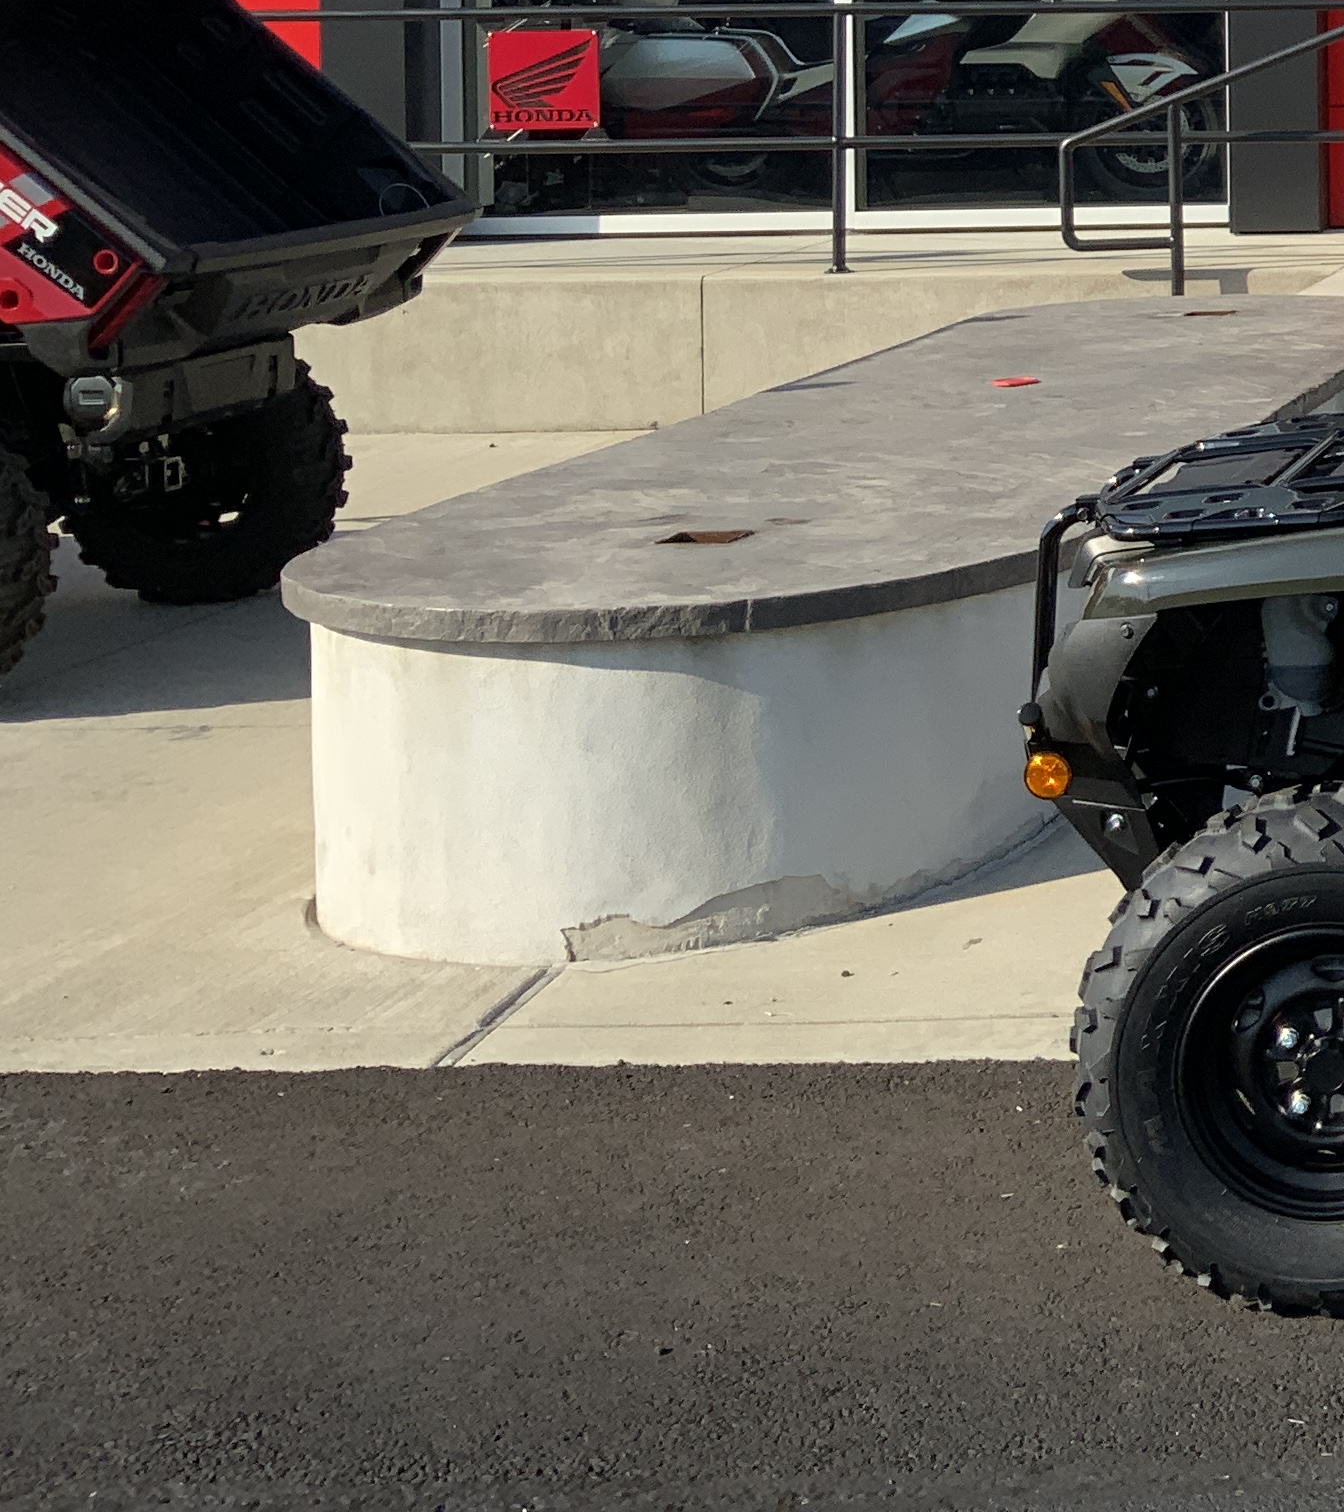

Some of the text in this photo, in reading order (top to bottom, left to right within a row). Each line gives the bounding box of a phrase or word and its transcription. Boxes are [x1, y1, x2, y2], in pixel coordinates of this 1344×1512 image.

[493, 108, 595, 123] HONDA
[0, 180, 60, 244] ER
[17, 242, 85, 301] HONDA
[231, 273, 372, 320] HONDA
